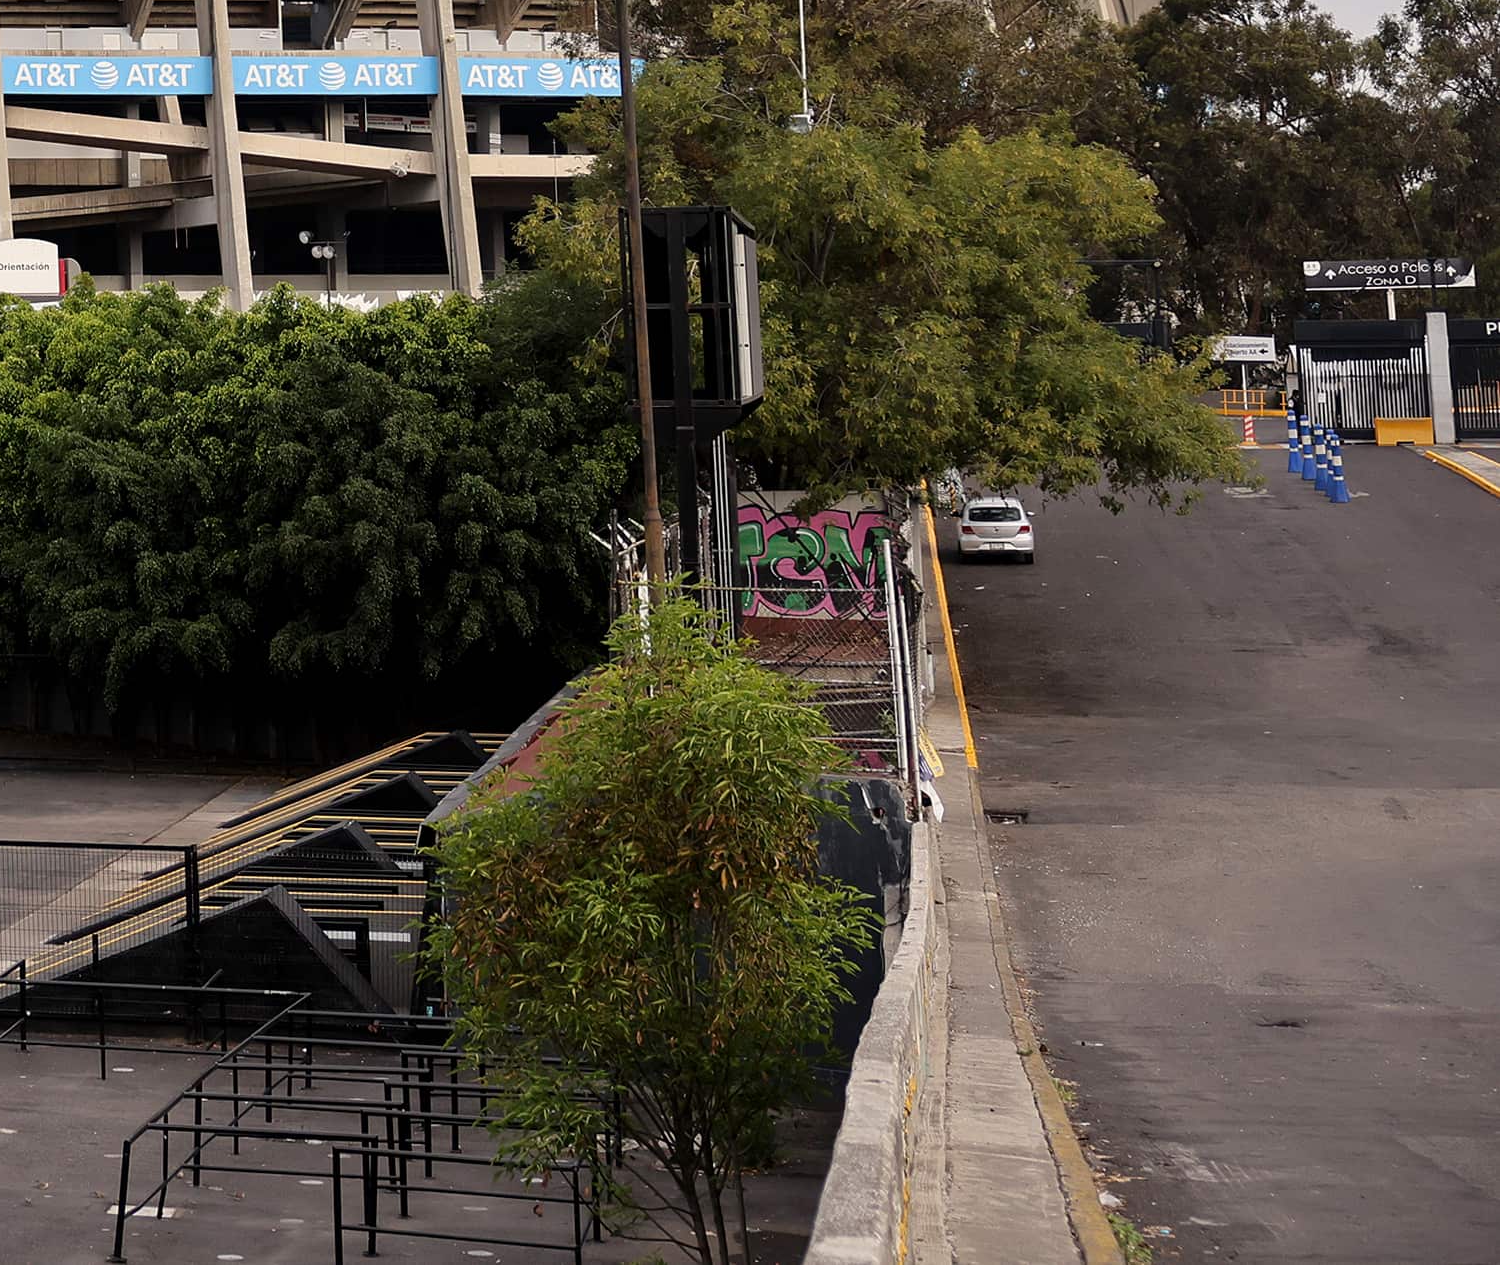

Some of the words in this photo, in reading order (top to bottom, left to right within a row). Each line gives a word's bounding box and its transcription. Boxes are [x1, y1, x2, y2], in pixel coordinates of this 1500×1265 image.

[14, 63, 80, 89] AT&T
[126, 64, 192, 89] AT&T
[244, 64, 308, 89] AT&T
[354, 64, 417, 89] AT&T
[467, 65, 529, 89] AT&T
[570, 65, 619, 89] AT&
[1338, 264, 1386, 275] Acceso
[1366, 276, 1401, 286] ZONA
[1404, 275, 1416, 285] D
